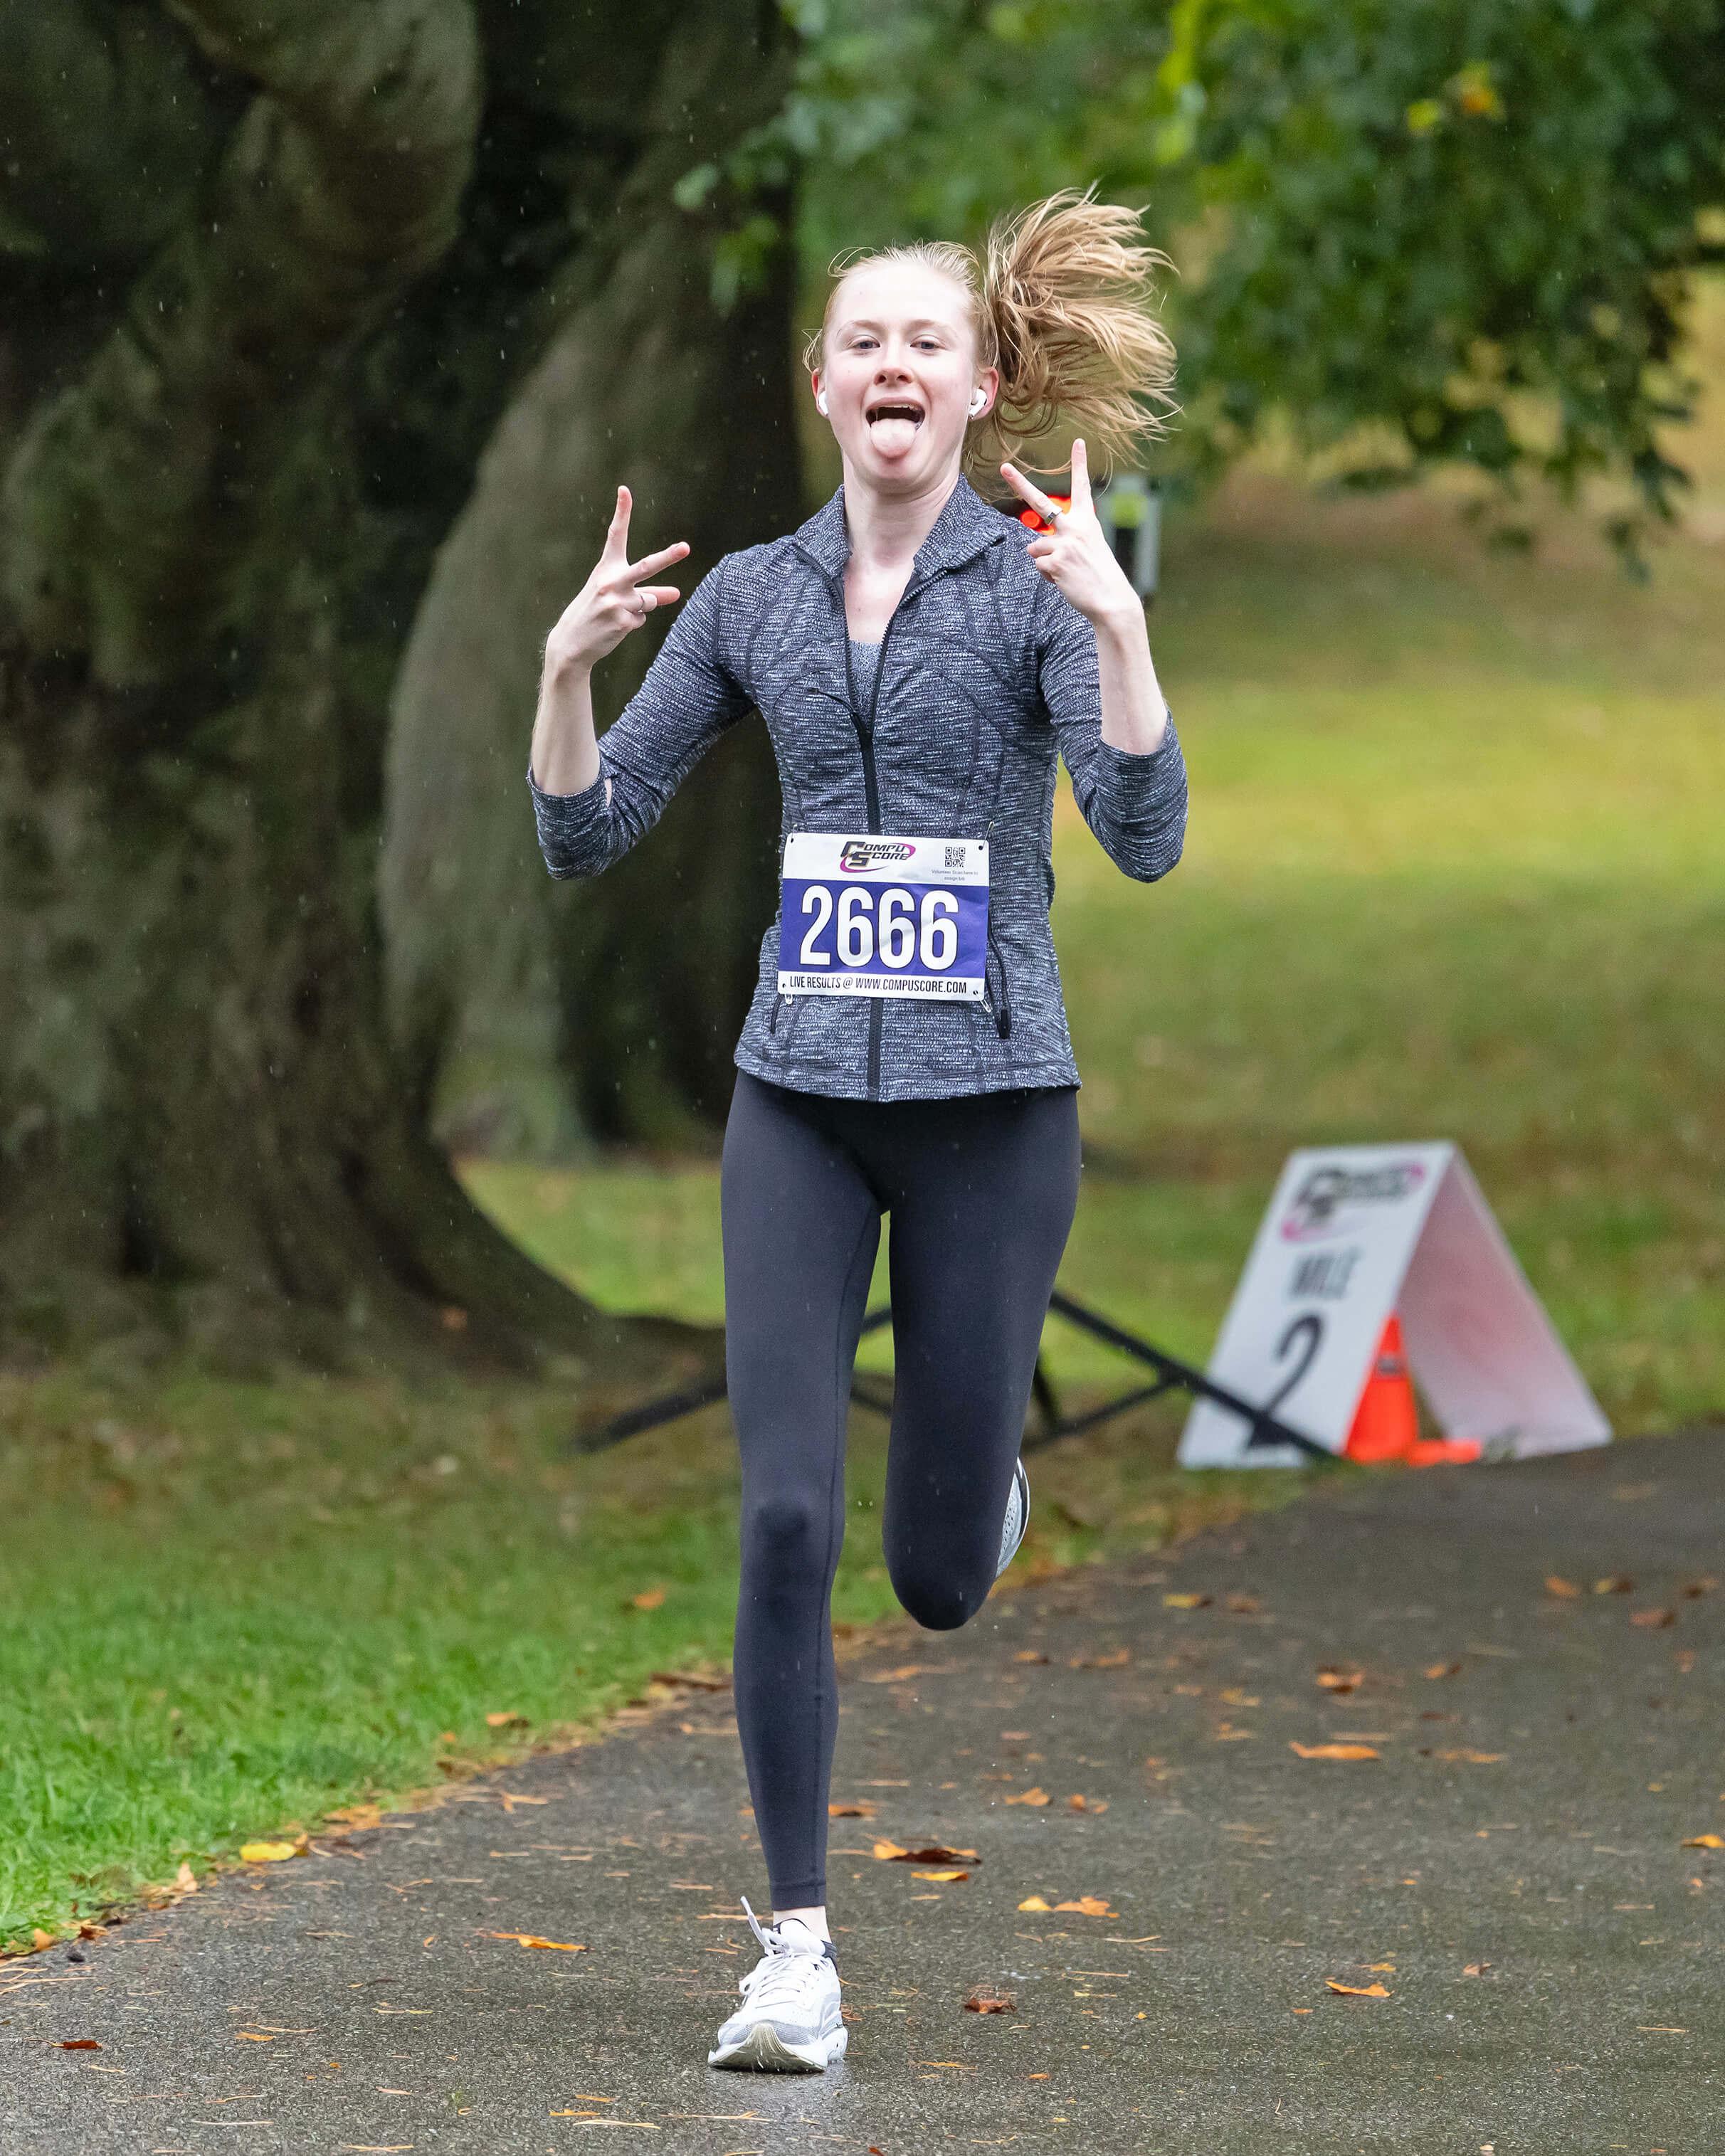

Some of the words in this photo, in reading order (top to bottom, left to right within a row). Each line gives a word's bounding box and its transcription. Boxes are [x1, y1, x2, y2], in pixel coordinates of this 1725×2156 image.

[840, 841, 906, 857] COMPU
[848, 852, 909, 867] SCORE
[800, 885, 959, 971] 2666
[790, 976, 806, 988] LIVE
[807, 977, 840, 988] RESULTS
[843, 977, 853, 989] @
[855, 978, 966, 993] WWW.COMPUSCORE.COM
[1247, 1314, 1324, 1447] 2
